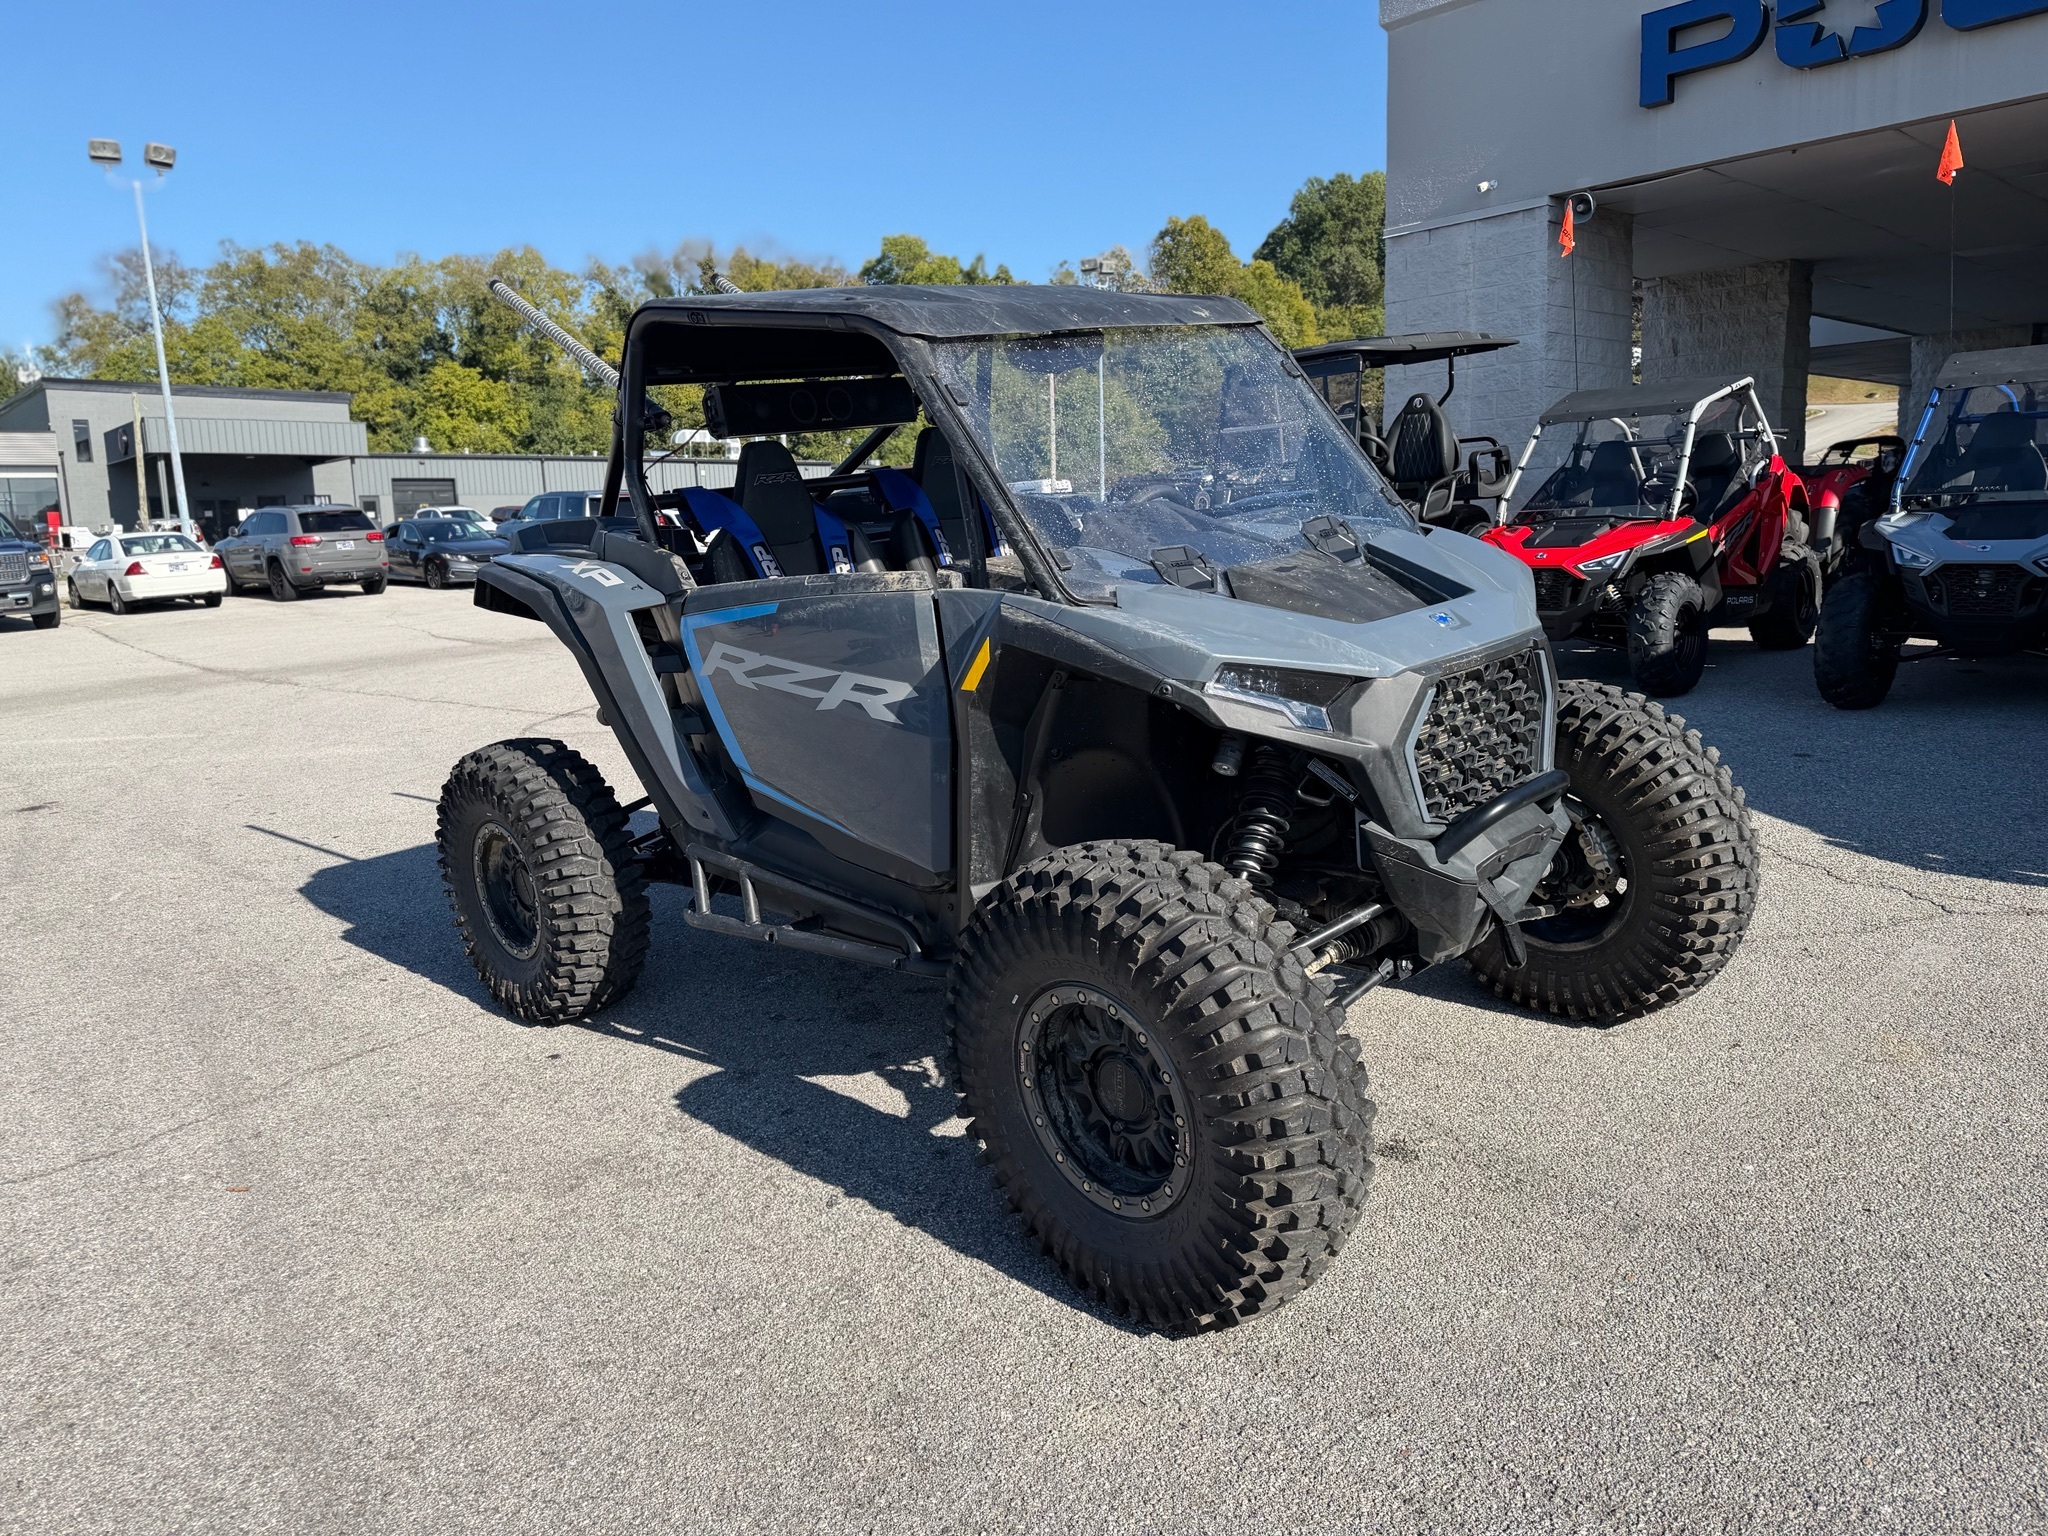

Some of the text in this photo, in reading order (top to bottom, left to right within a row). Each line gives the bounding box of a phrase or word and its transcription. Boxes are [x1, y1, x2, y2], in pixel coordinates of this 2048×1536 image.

[754, 471, 799, 486] RZR
[558, 560, 625, 588] XP
[753, 545, 782, 579] RP
[831, 547, 851, 574] RP
[1726, 595, 1754, 605] POLARIS
[700, 640, 919, 725] RZR
